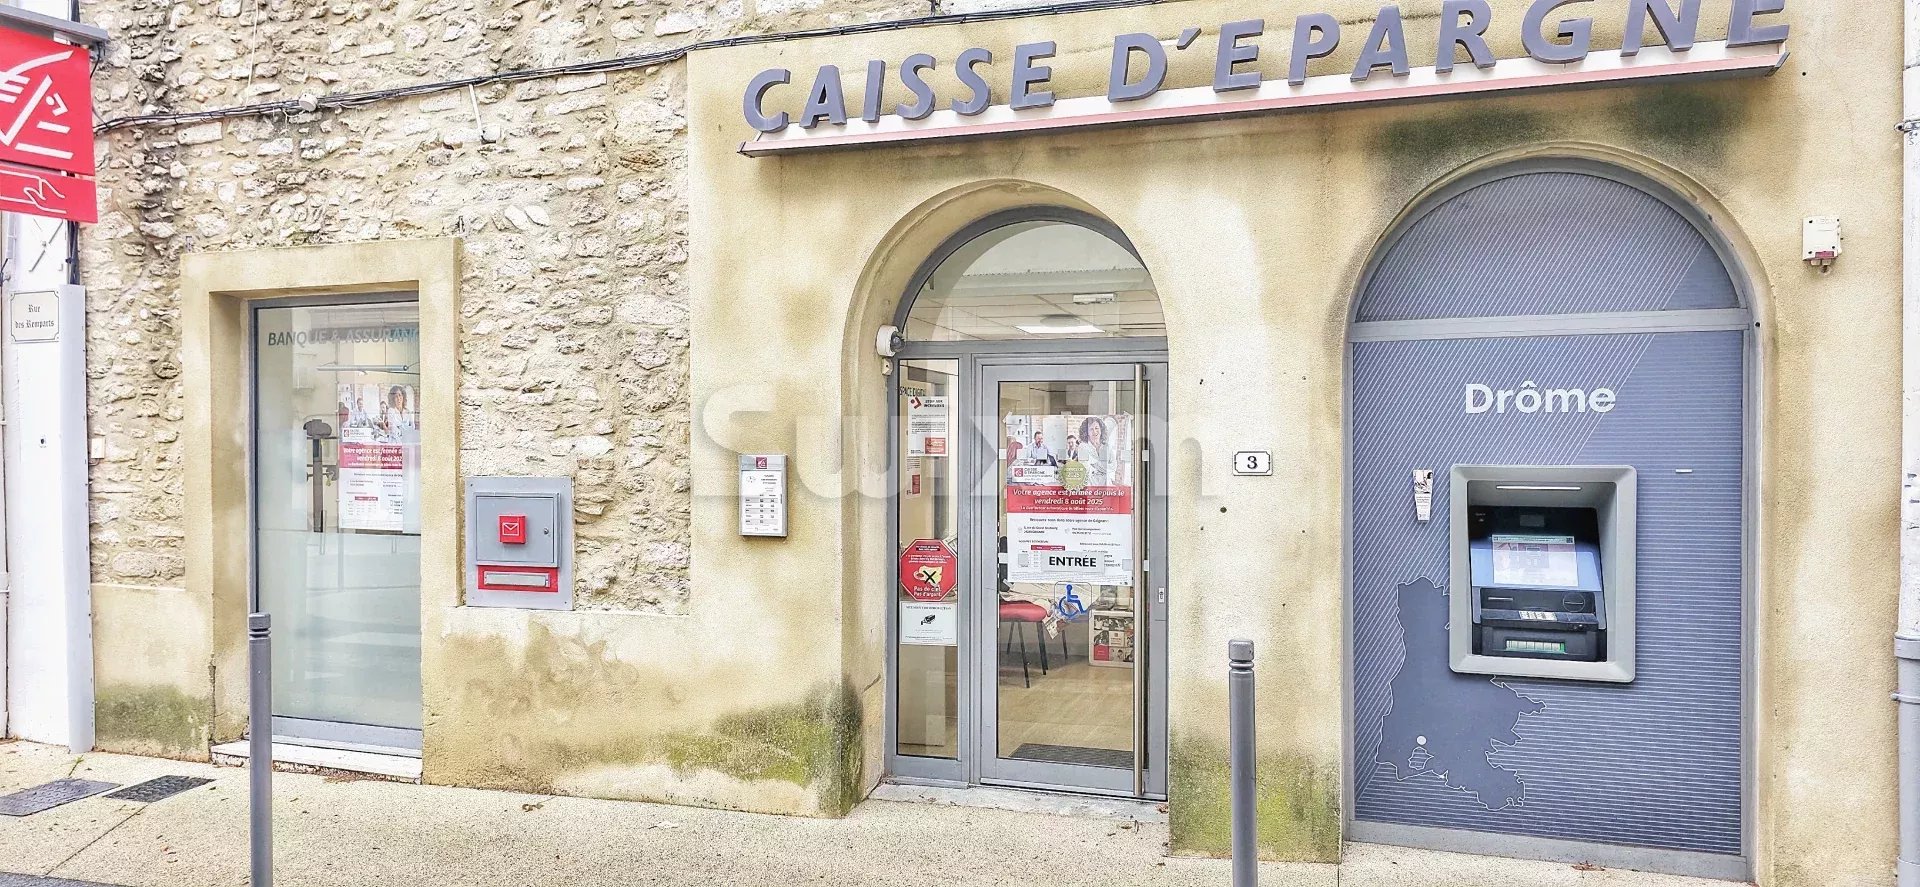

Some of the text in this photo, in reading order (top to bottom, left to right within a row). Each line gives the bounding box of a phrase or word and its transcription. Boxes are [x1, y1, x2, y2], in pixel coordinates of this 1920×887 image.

[743, 41, 1057, 133] CAISSE
[28, 304, 41, 313] Rue
[15, 319, 55, 329] des Remparts
[268, 330, 327, 348] BANQUE
[331, 330, 340, 344] &
[1466, 380, 1616, 414] Drôme
[1247, 455, 1258, 470] 3
[1013, 488, 1032, 496] Votre
[1033, 489, 1056, 497] agence
[1069, 488, 1093, 497] fermée
[1094, 488, 1117, 497] depuis
[1118, 488, 1125, 496] le
[1034, 497, 1064, 505] vendredi
[1070, 497, 1086, 505] août
[1049, 554, 1097, 567] ENTRÉE
